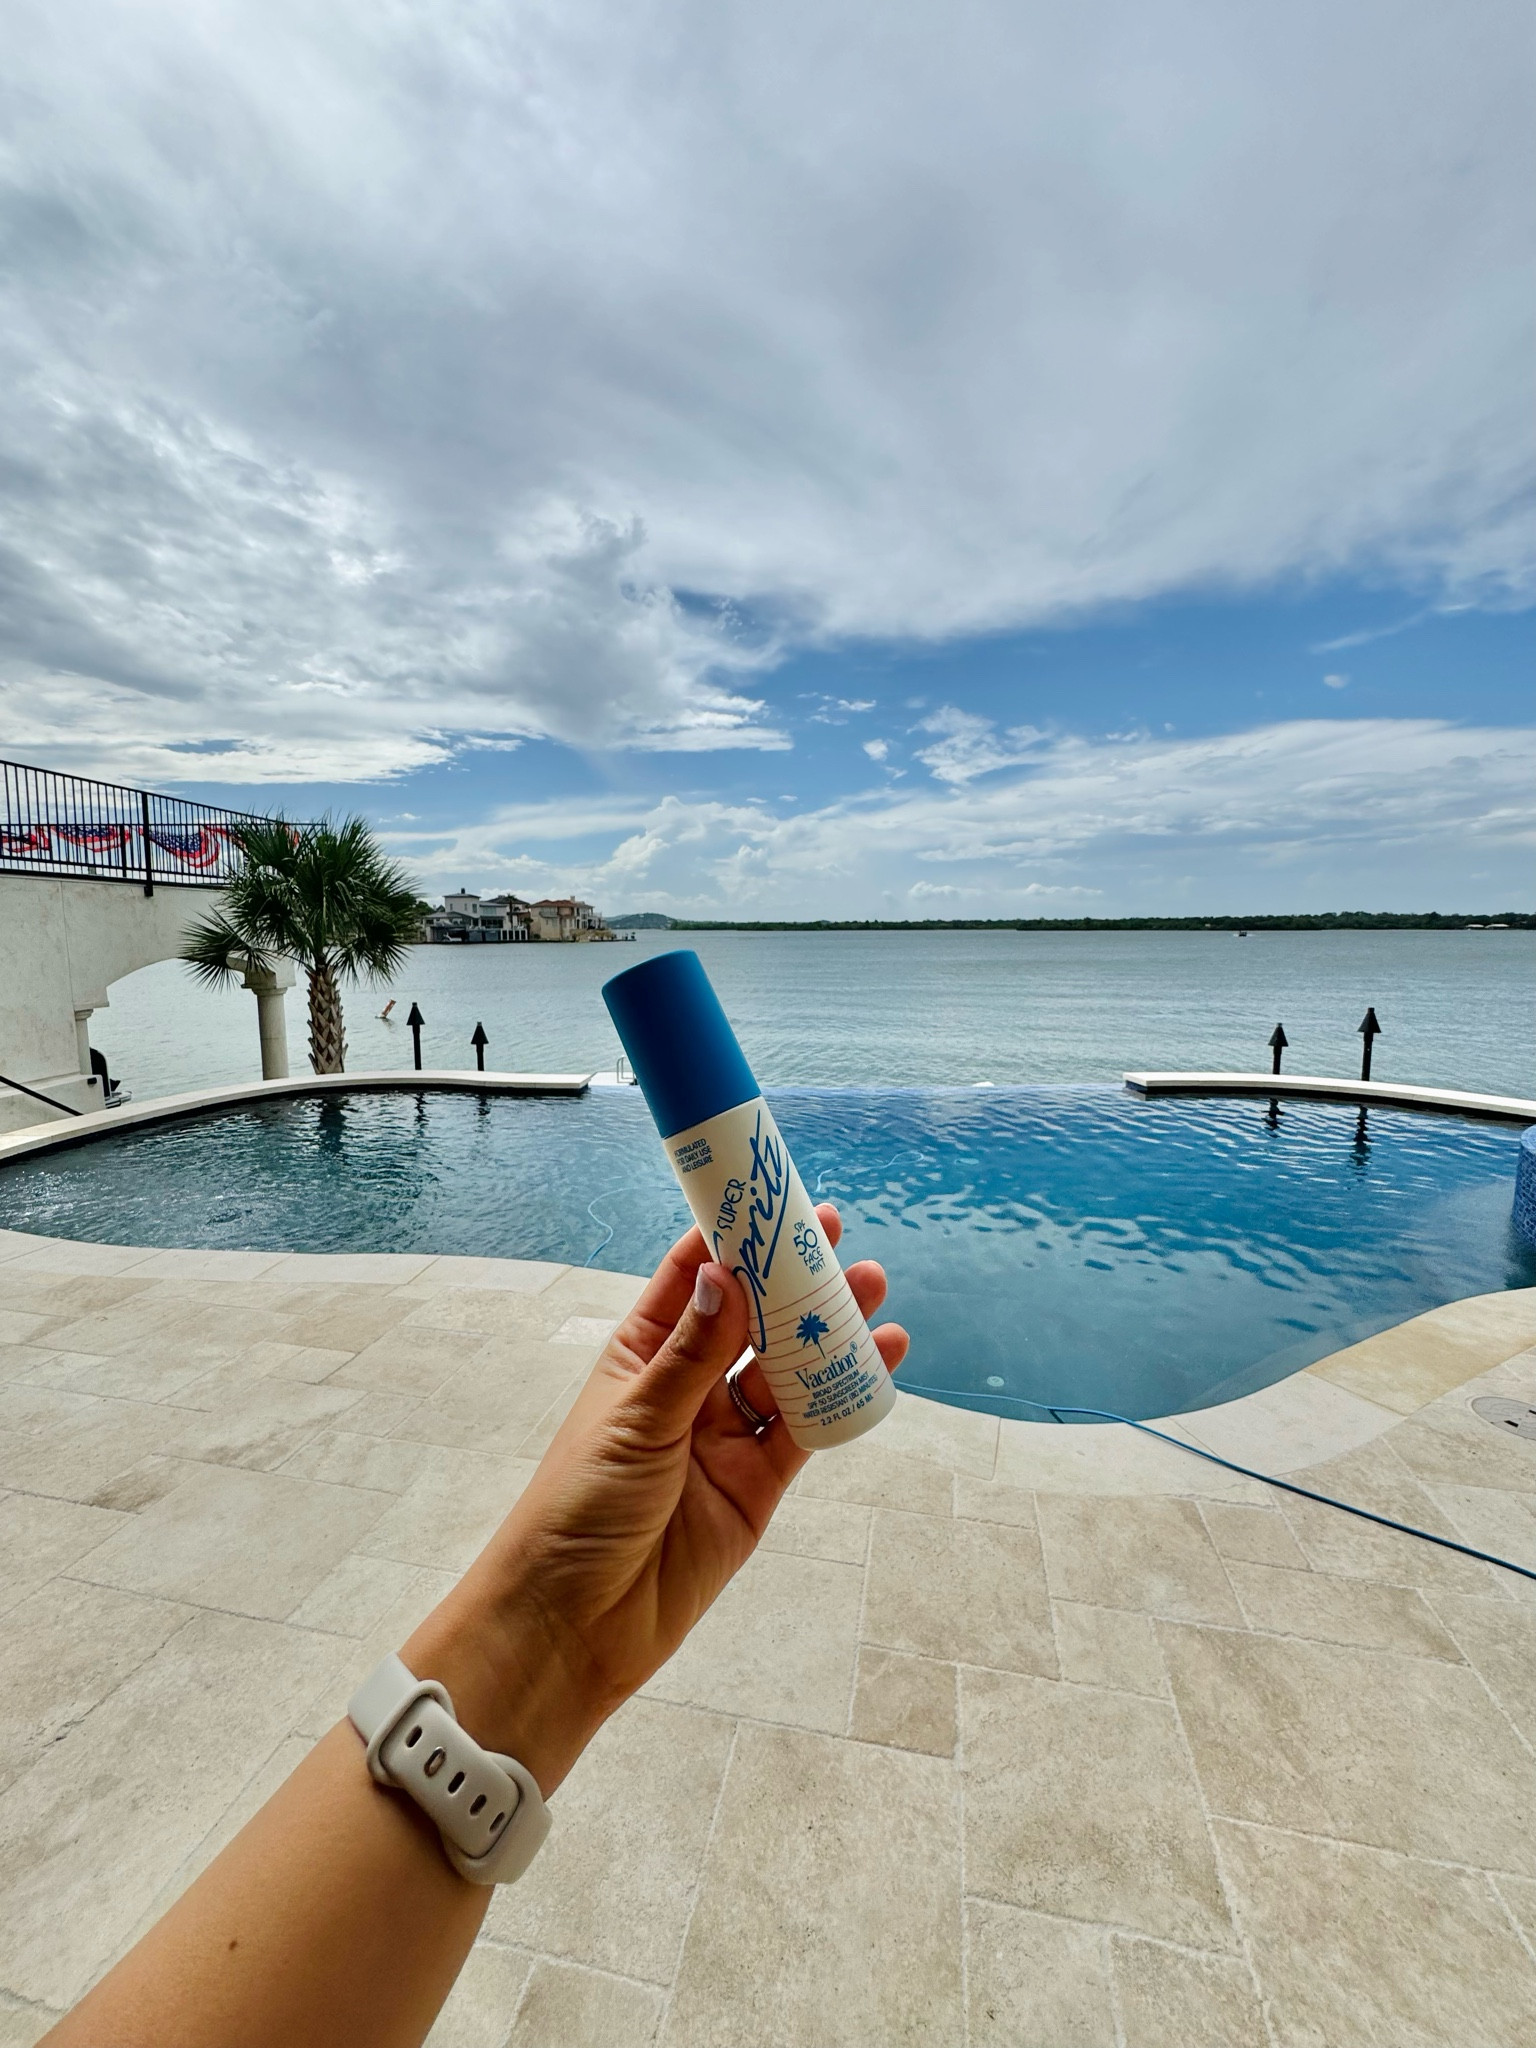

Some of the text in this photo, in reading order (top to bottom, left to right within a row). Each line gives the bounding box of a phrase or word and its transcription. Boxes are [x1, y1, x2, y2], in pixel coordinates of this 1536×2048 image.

[674, 1138, 707, 1157] FORMULATED
[677, 1145, 712, 1166] FOR DAILY USE
[682, 1155, 714, 1173] AND LEISURE
[717, 1178, 746, 1231] SUPER
[794, 1219, 806, 1233] SPF
[793, 1228, 818, 1255] 50
[803, 1246, 824, 1266] FACE
[809, 1257, 826, 1276] MIST
[807, 1371, 869, 1410] SPF 50 SUNSCREEN MIST
[812, 1368, 860, 1399] BROAD SPECTRUM
[803, 1408, 820, 1419] WATER
[820, 1396, 849, 1414] RESISTANT
[820, 1416, 833, 1426] 2.2
[833, 1412, 842, 1421] FL
[841, 1407, 851, 1417] OZ
[856, 1398, 865, 1409] 65
